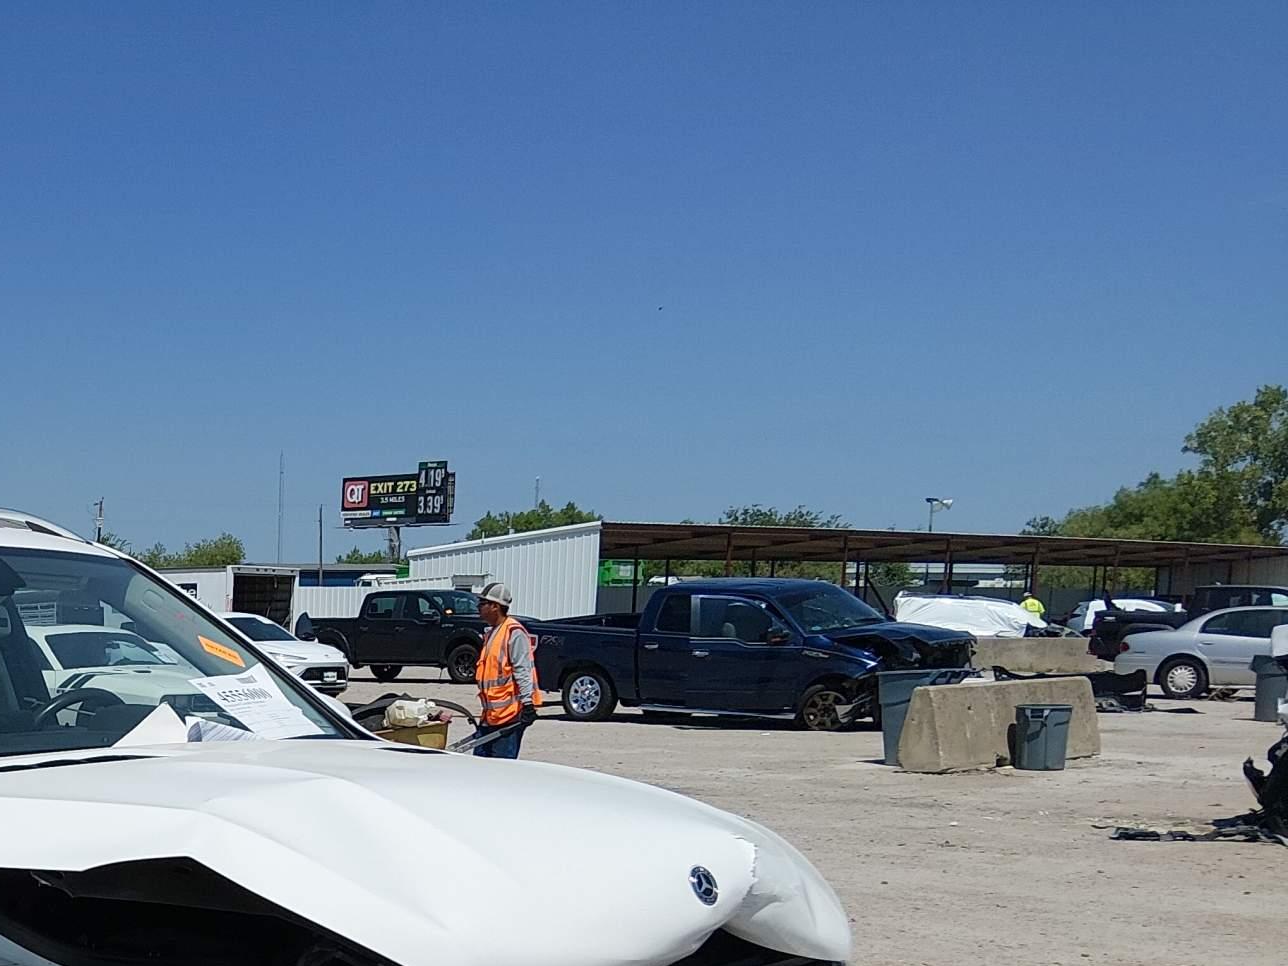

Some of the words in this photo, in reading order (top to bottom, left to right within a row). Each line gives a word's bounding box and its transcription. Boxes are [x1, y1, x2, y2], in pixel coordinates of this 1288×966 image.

[346, 484, 364, 504] QT
[369, 482, 394, 495] EXIT
[396, 480, 417, 492] 273
[389, 495, 406, 503] MILES
